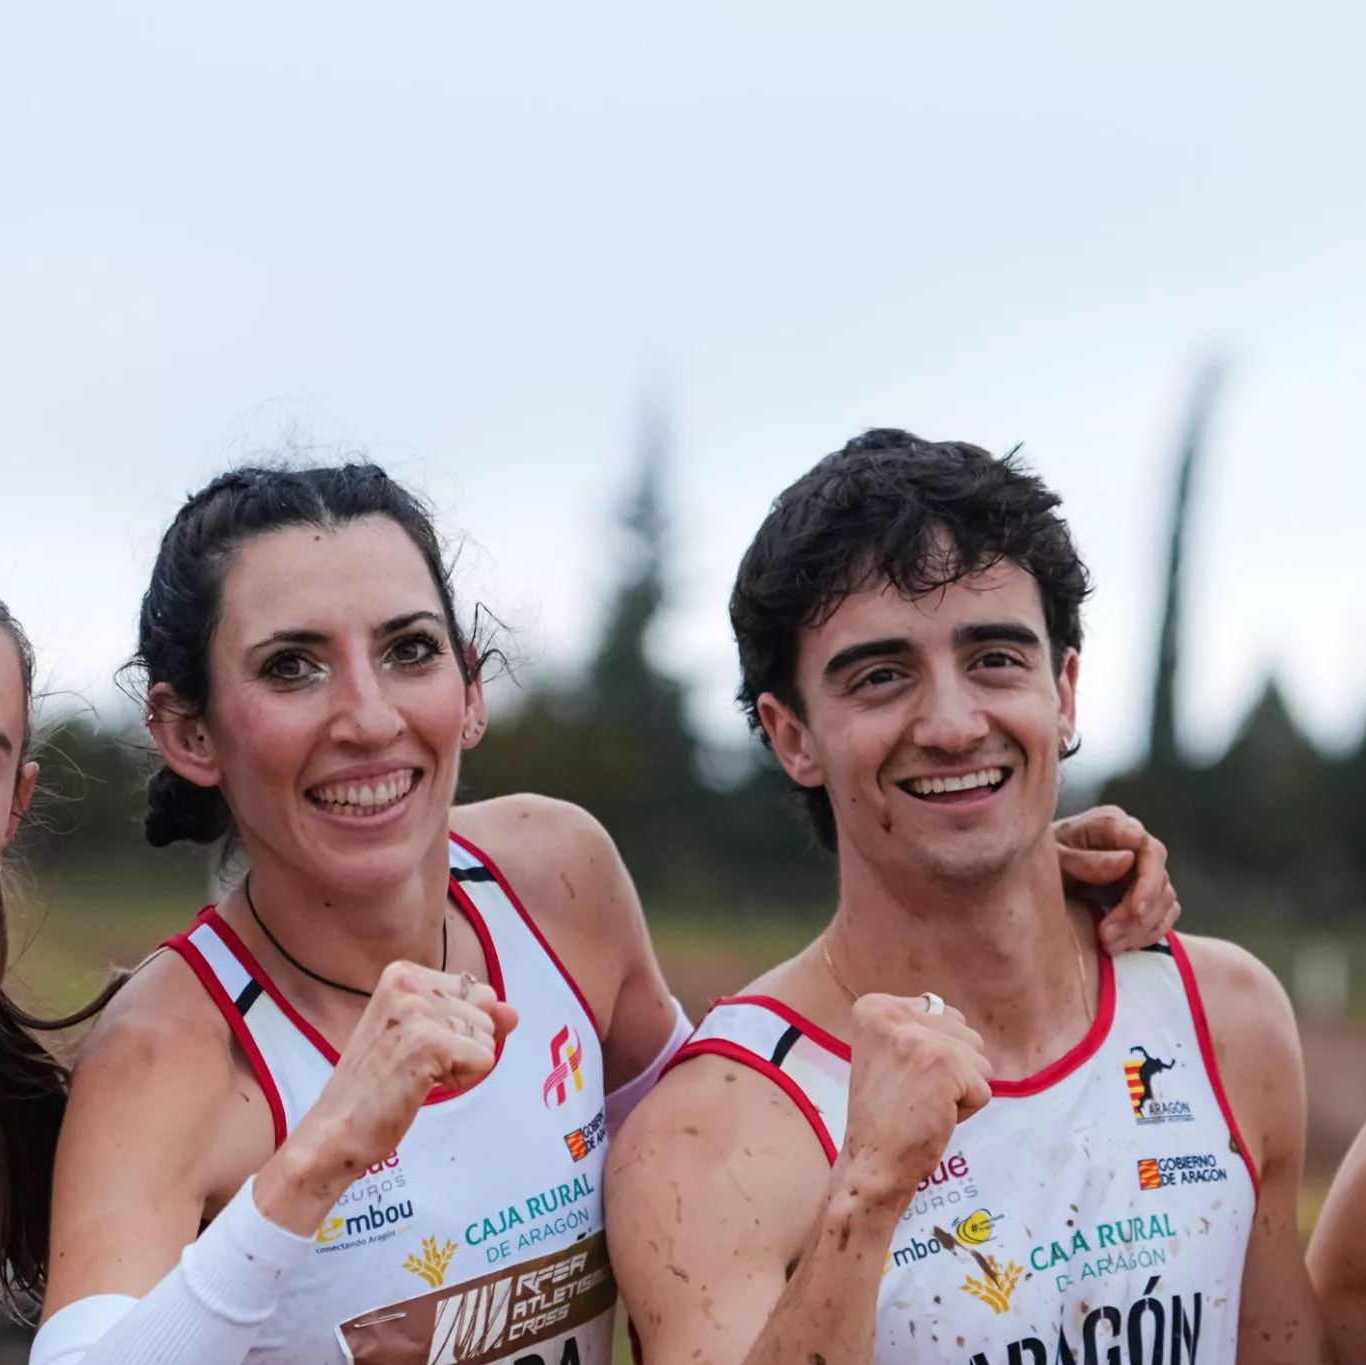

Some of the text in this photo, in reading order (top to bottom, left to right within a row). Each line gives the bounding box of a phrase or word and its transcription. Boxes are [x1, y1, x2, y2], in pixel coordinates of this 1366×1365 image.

[1158, 1154, 1217, 1172] GOBIERNO
[1161, 1172, 1176, 1186] DE
[317, 1199, 413, 1243] embou
[465, 1173, 594, 1246] CAJA RURAL
[486, 1207, 589, 1264] DE ARAGÓN
[1096, 1213, 1176, 1249] RURAL
[516, 1251, 588, 1297] RFEA
[509, 1303, 570, 1341] CROSS
